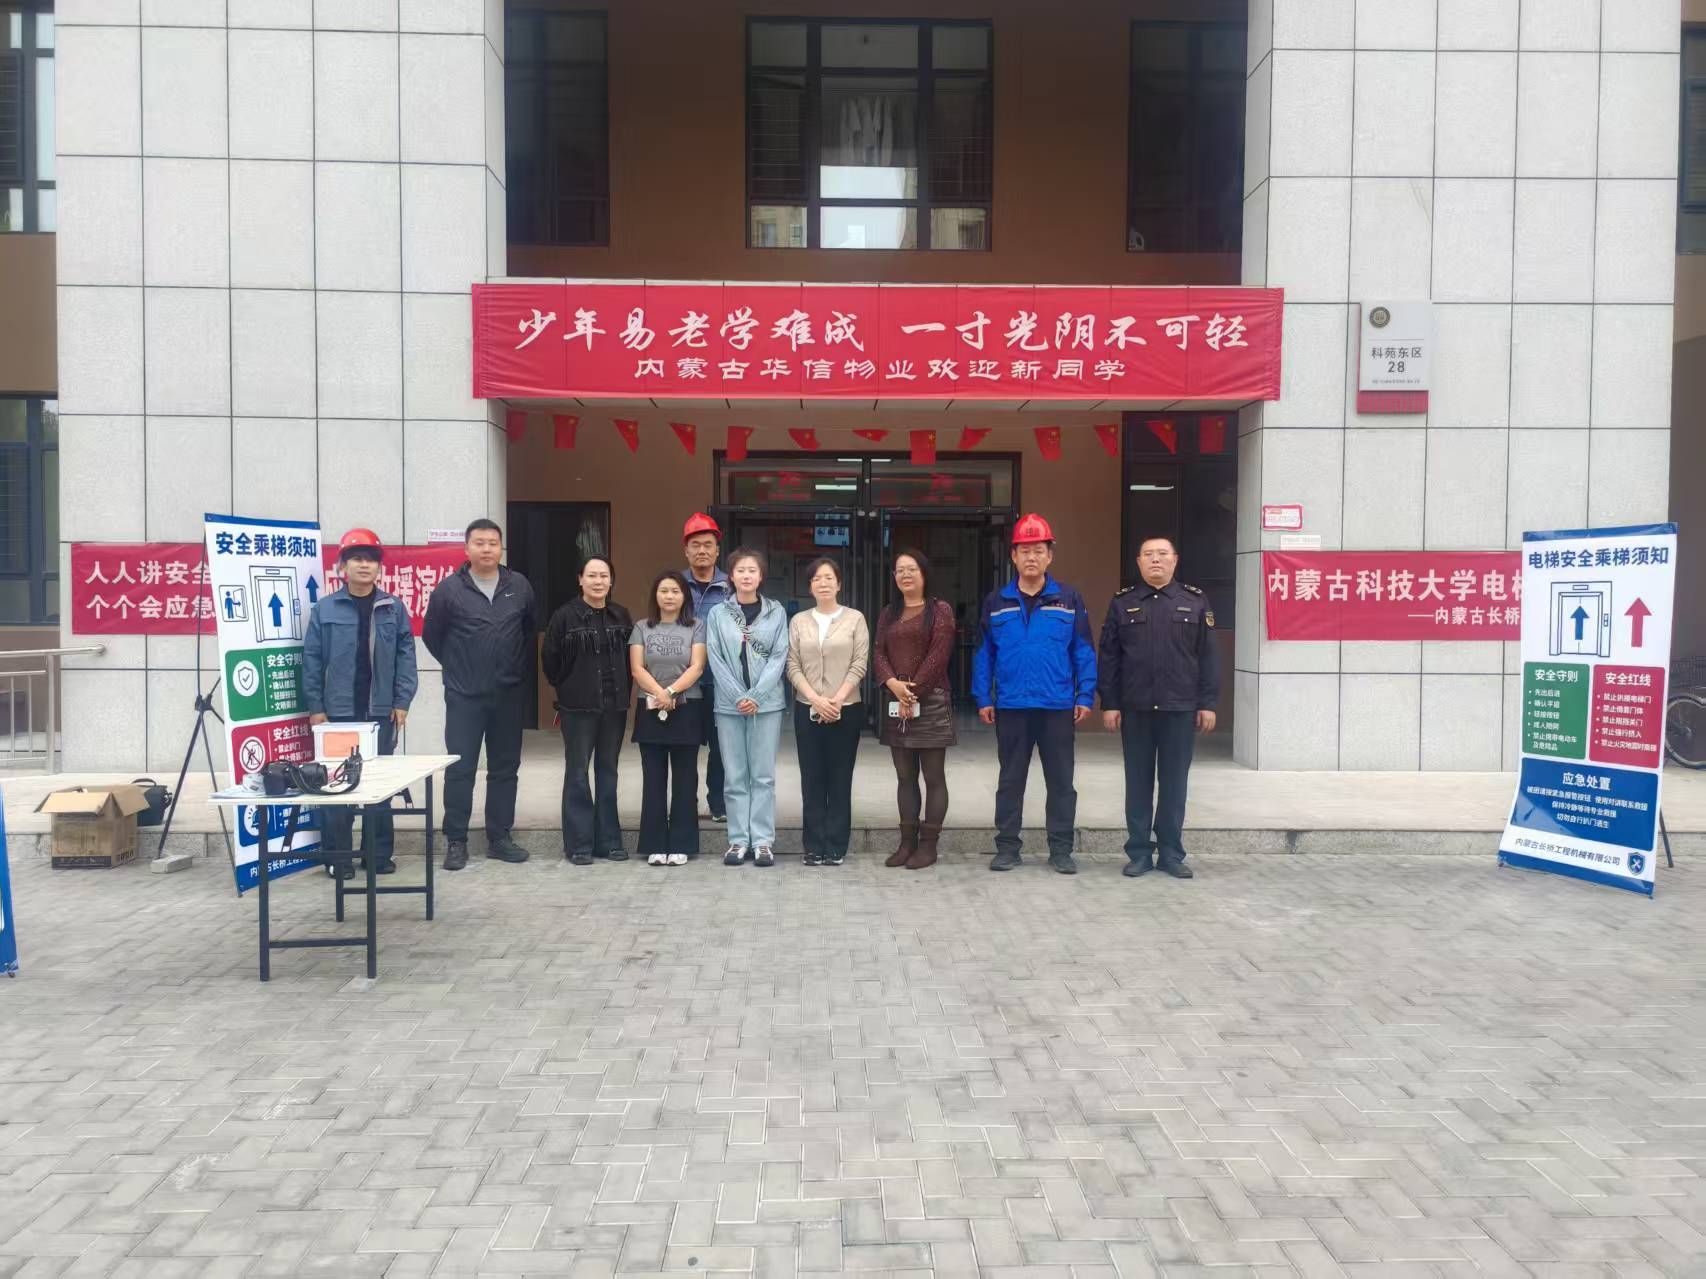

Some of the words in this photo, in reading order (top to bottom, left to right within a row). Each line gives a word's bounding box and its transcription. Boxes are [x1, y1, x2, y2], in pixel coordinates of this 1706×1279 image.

[515, 307, 864, 351] 少年易老学难成
[901, 310, 1249, 351] 一寸光阴不可轻
[1371, 346, 1422, 359] 科苑东区
[634, 358, 1126, 381] 内蒙古华信物业欢迎新同学
[1388, 361, 1405, 373] 28
[216, 531, 317, 557] 安全乘梯须知
[1528, 546, 1669, 569] 电梯安全乘梯须知
[86, 594, 217, 619] 个个会应急
[1534, 669, 1579, 683] 安全守则
[1605, 672, 1652, 687] 安全红线
[1562, 772, 1611, 791] 应急处置
[1515, 838, 1621, 866] 内蒙古长桥工程机械有限公司
